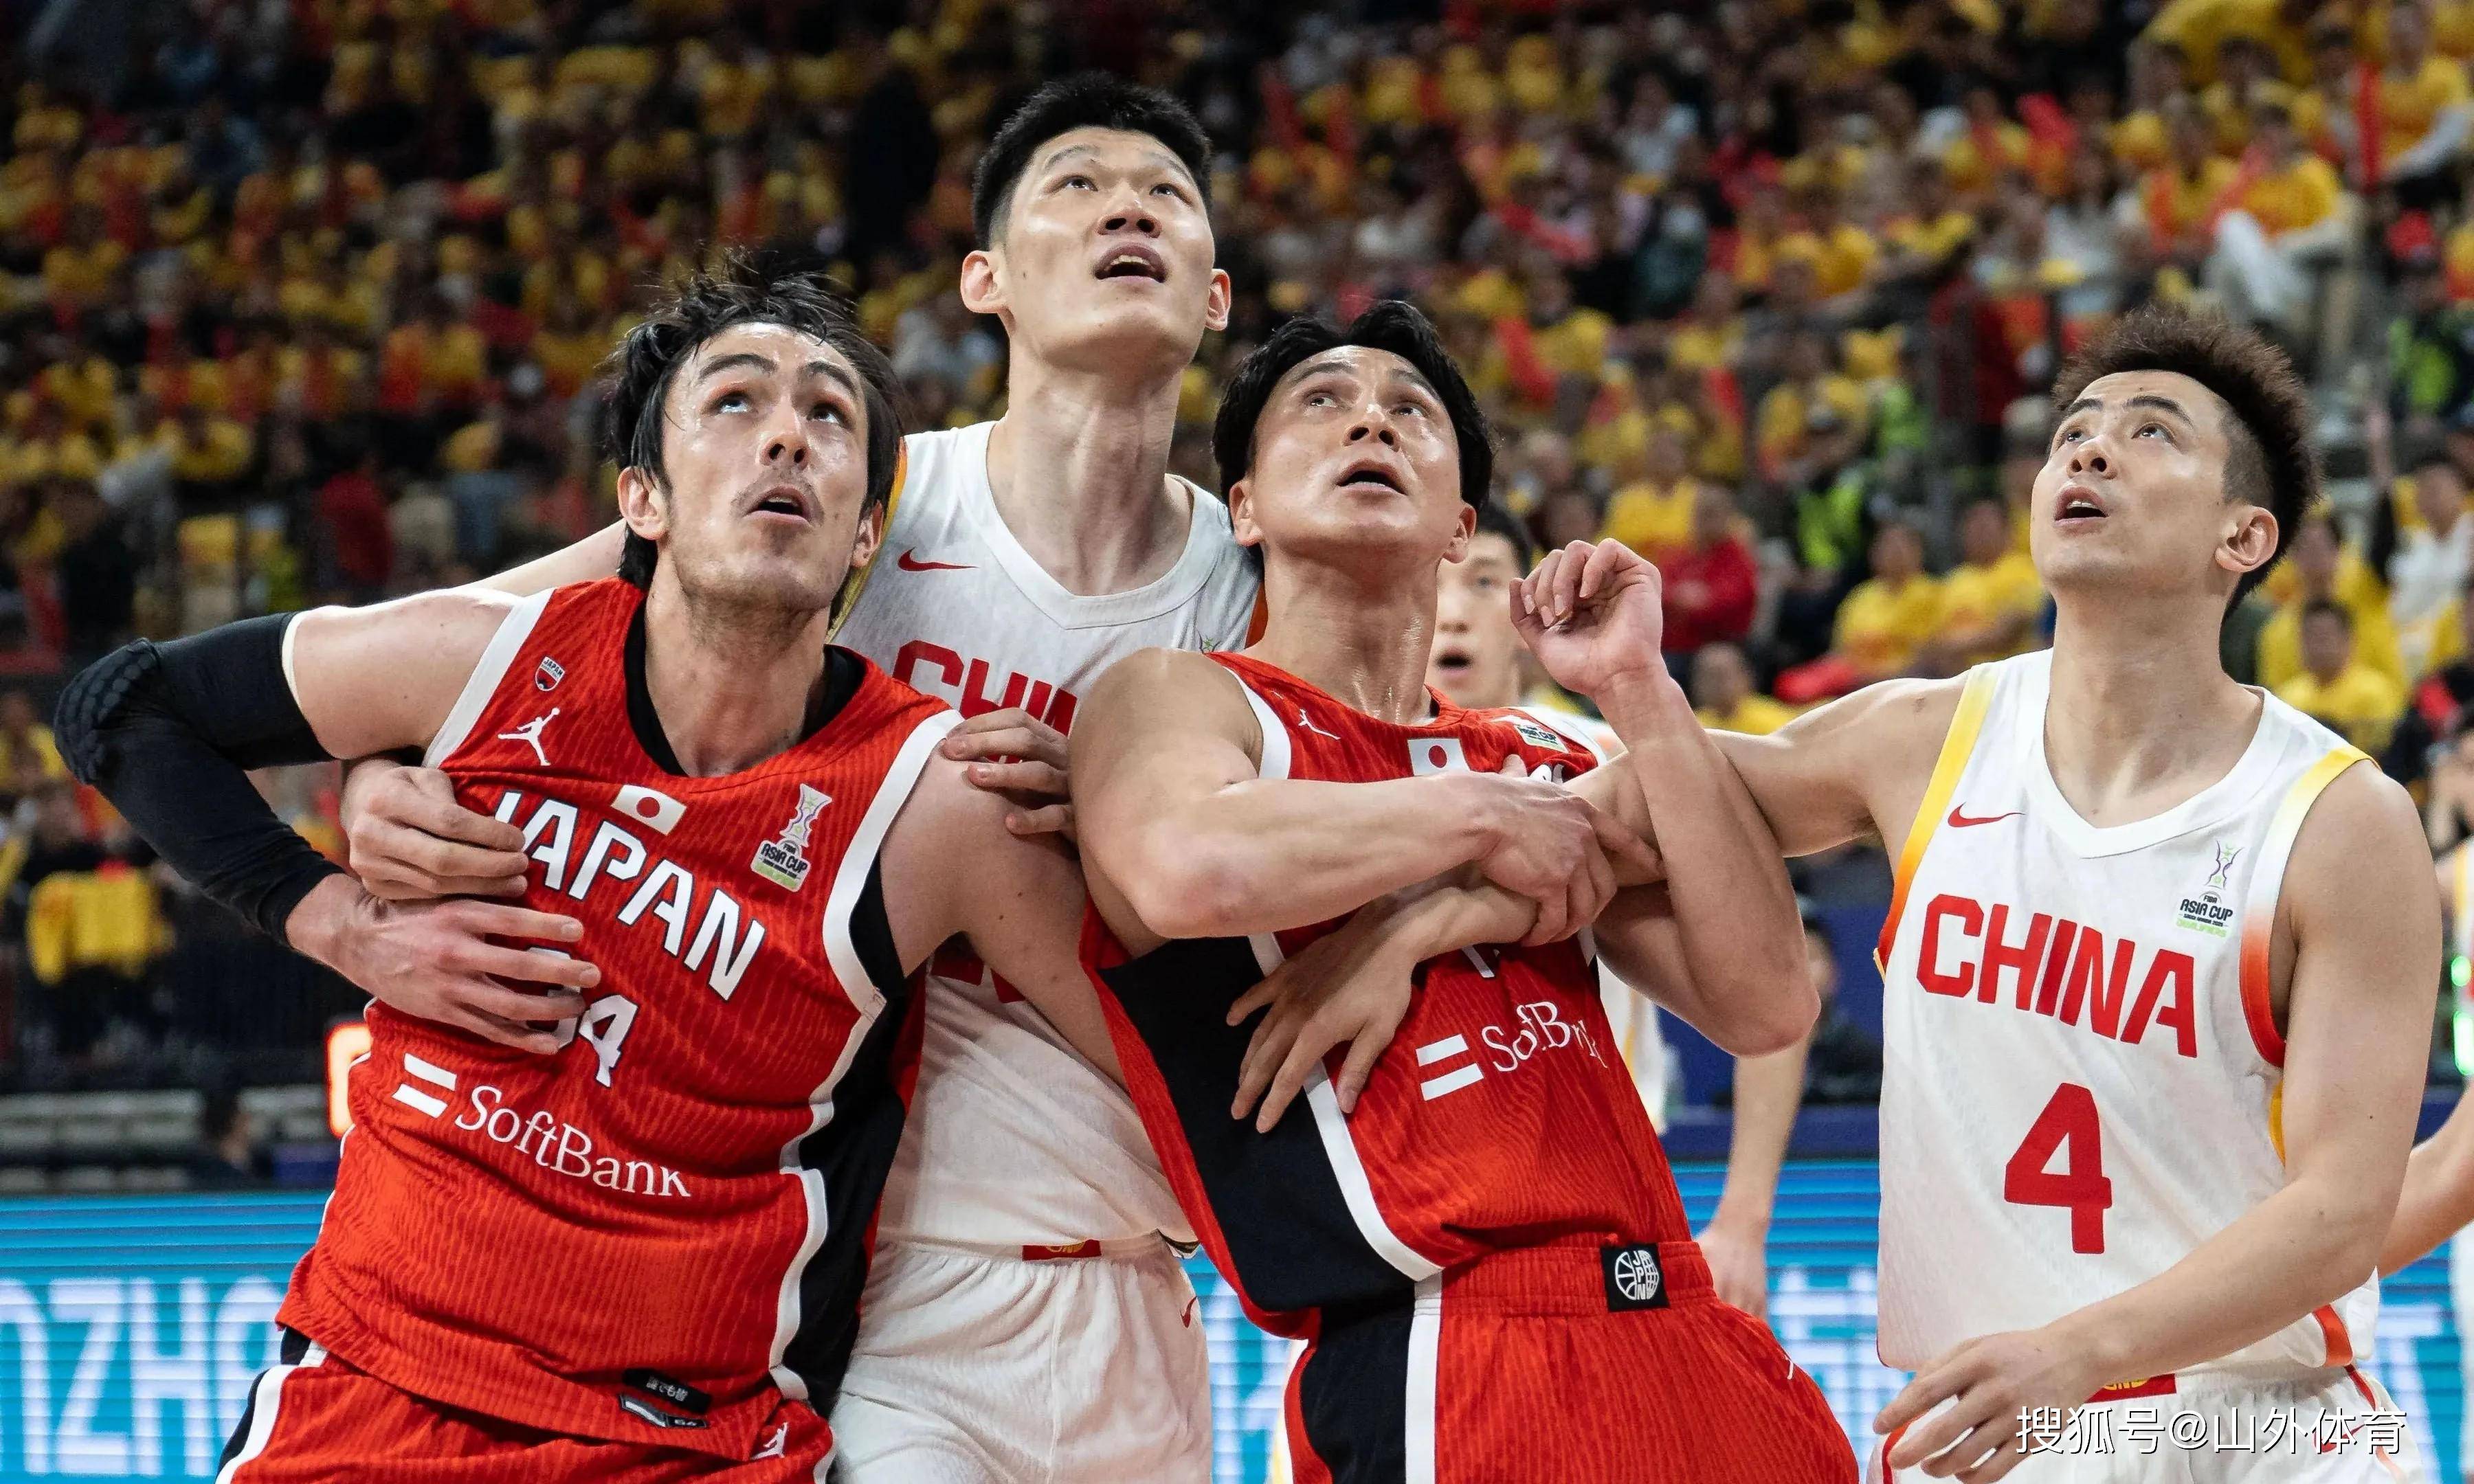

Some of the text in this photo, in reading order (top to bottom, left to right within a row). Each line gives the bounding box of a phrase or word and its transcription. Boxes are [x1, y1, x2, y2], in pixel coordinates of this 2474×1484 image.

[761, 843, 787, 864] ASIA
[785, 855, 808, 873] CUP
[2180, 899, 2208, 916] ASIA
[2208, 906, 2233, 921] CUP
[2203, 895, 2218, 903] FIBA
[1917, 894, 2198, 1058] CHINA
[454, 1086, 691, 1197] SoftBank
[2004, 1083, 2112, 1254] 4
